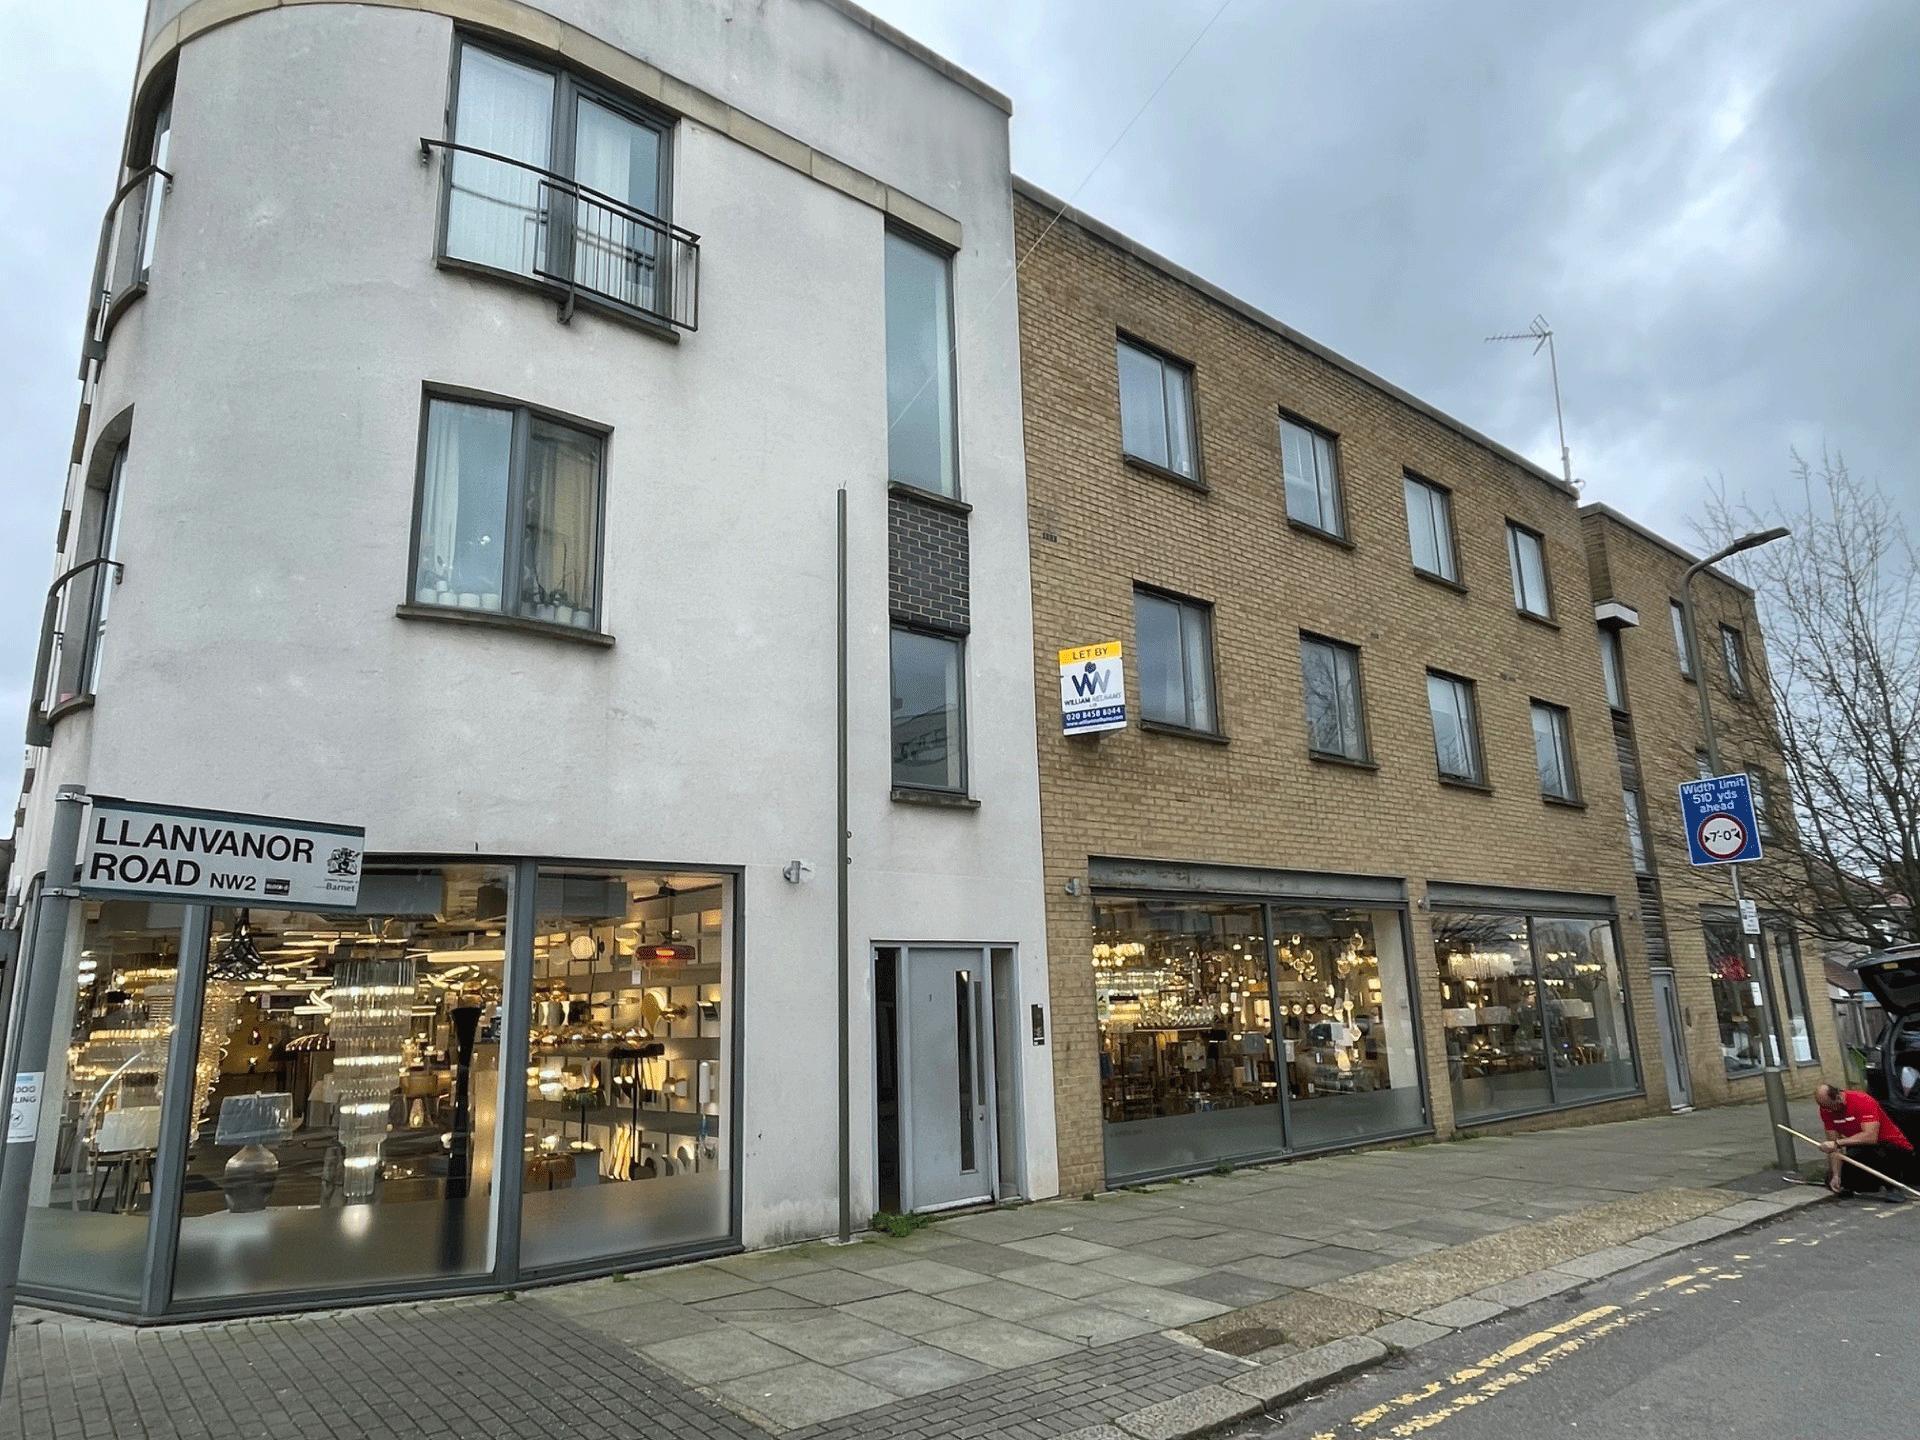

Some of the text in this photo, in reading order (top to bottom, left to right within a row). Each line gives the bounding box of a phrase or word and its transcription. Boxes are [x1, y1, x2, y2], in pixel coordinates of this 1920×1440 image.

[1073, 647, 1108, 660] LET BY
[1064, 697, 1090, 706] WILLIAM
[1066, 707, 1121, 721] 020 8458 8044
[1682, 782, 1715, 794] Width
[1692, 790, 1737, 804] 510 yds
[1700, 800, 1735, 813] ahead
[95, 817, 314, 863] LLANVANOR
[89, 852, 200, 886] ROAD
[209, 872, 256, 891] NW2
[326, 882, 355, 892] Barnet
